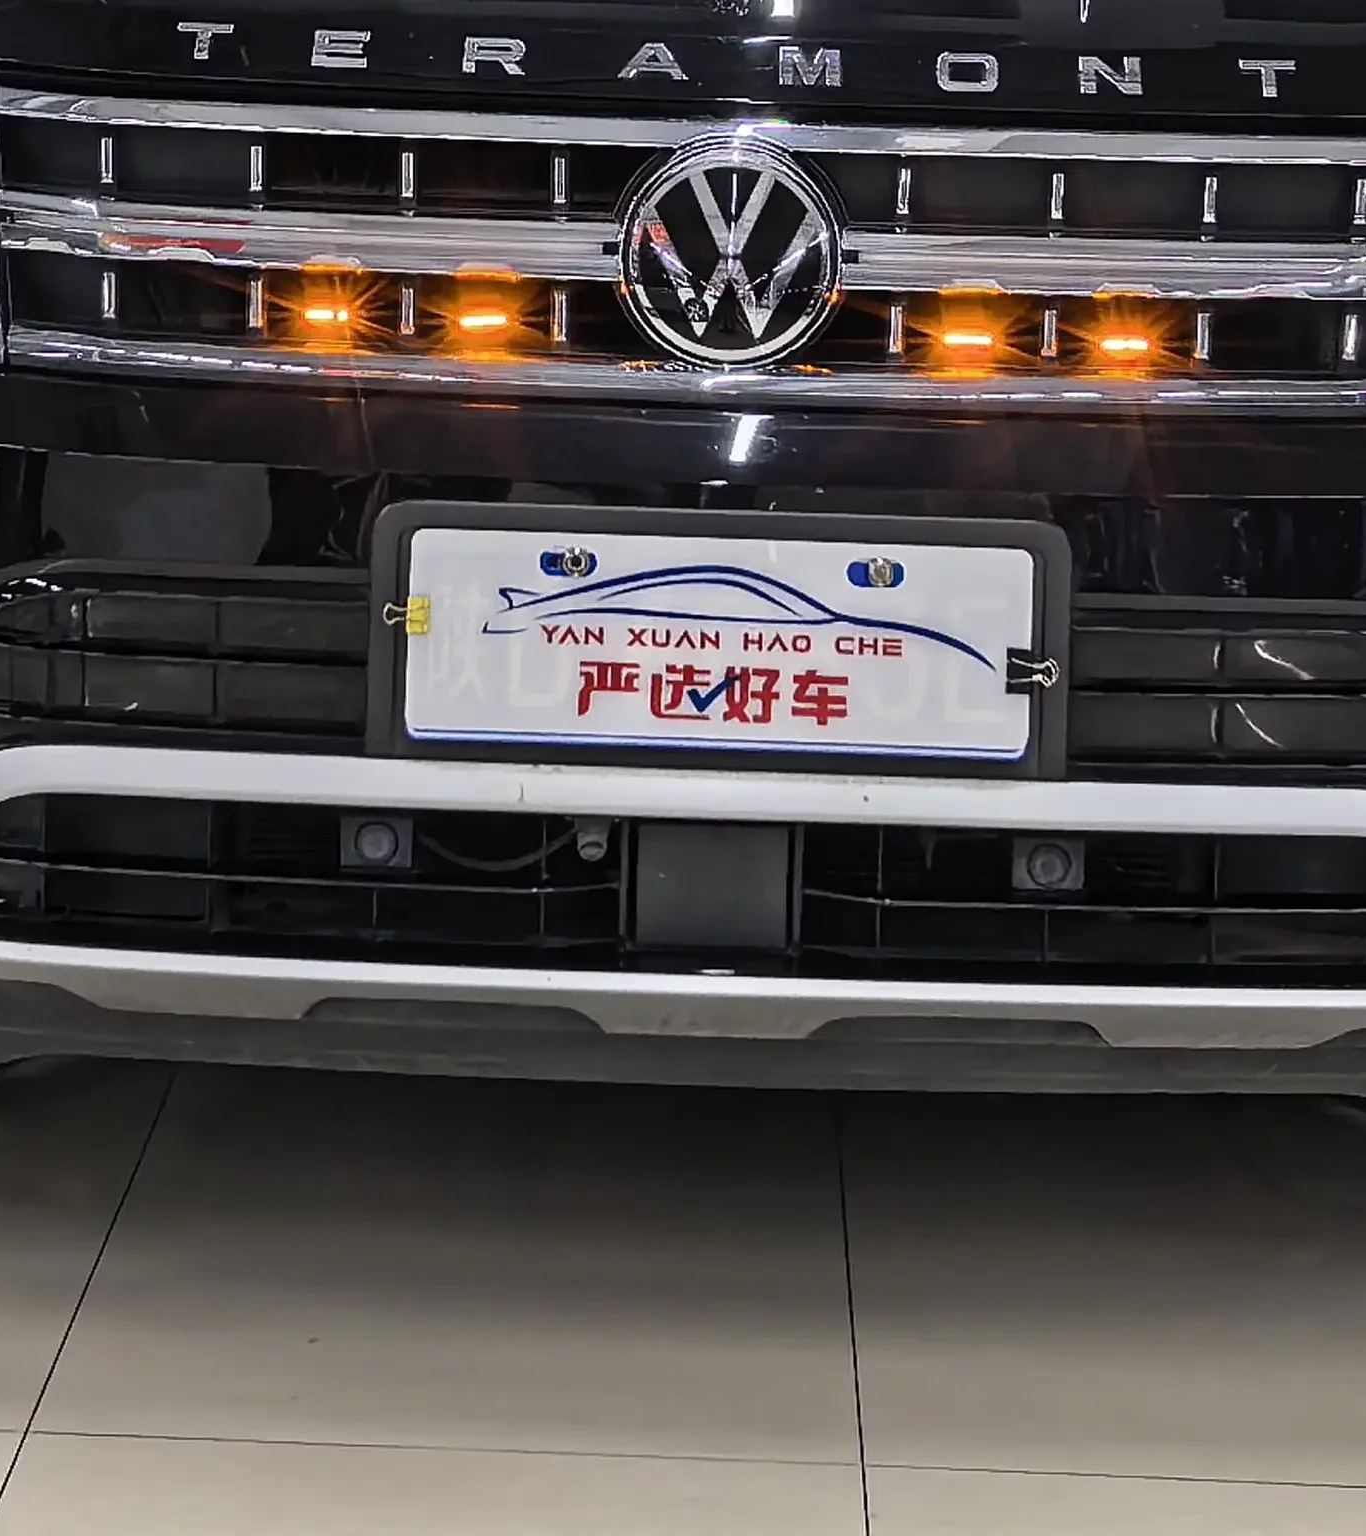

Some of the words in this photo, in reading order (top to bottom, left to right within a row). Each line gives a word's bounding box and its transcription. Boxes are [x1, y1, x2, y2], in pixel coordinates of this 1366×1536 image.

[175, 21, 1298, 99] TERAMONT
[540, 624, 605, 646] YAN
[626, 627, 721, 651] XUAN
[742, 631, 812, 654] HAO
[834, 636, 904, 658] CHE
[576, 660, 850, 726] 严选好车
